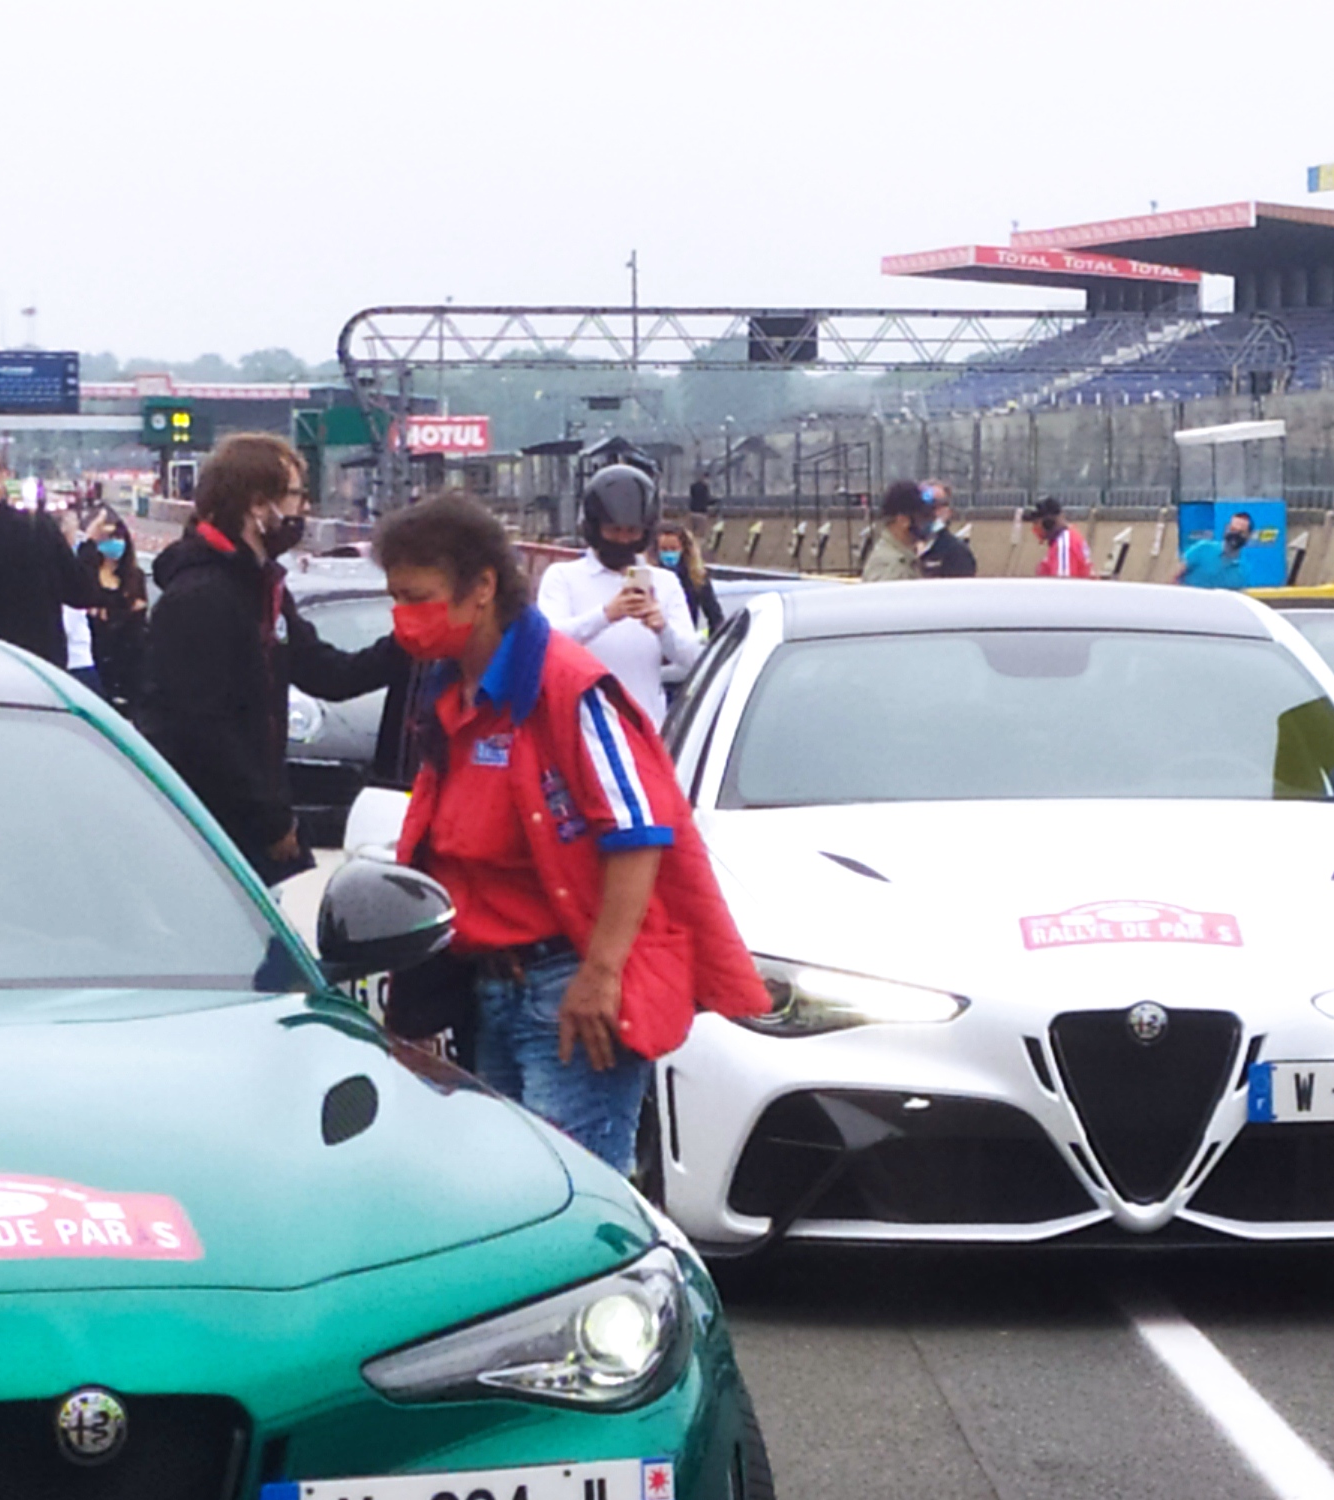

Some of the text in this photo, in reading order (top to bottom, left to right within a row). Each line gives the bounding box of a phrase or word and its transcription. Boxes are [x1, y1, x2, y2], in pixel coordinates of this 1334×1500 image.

[1063, 255, 1117, 273] TOTAL
[1128, 260, 1184, 277] TOTAL
[1121, 921, 1152, 938] DE
